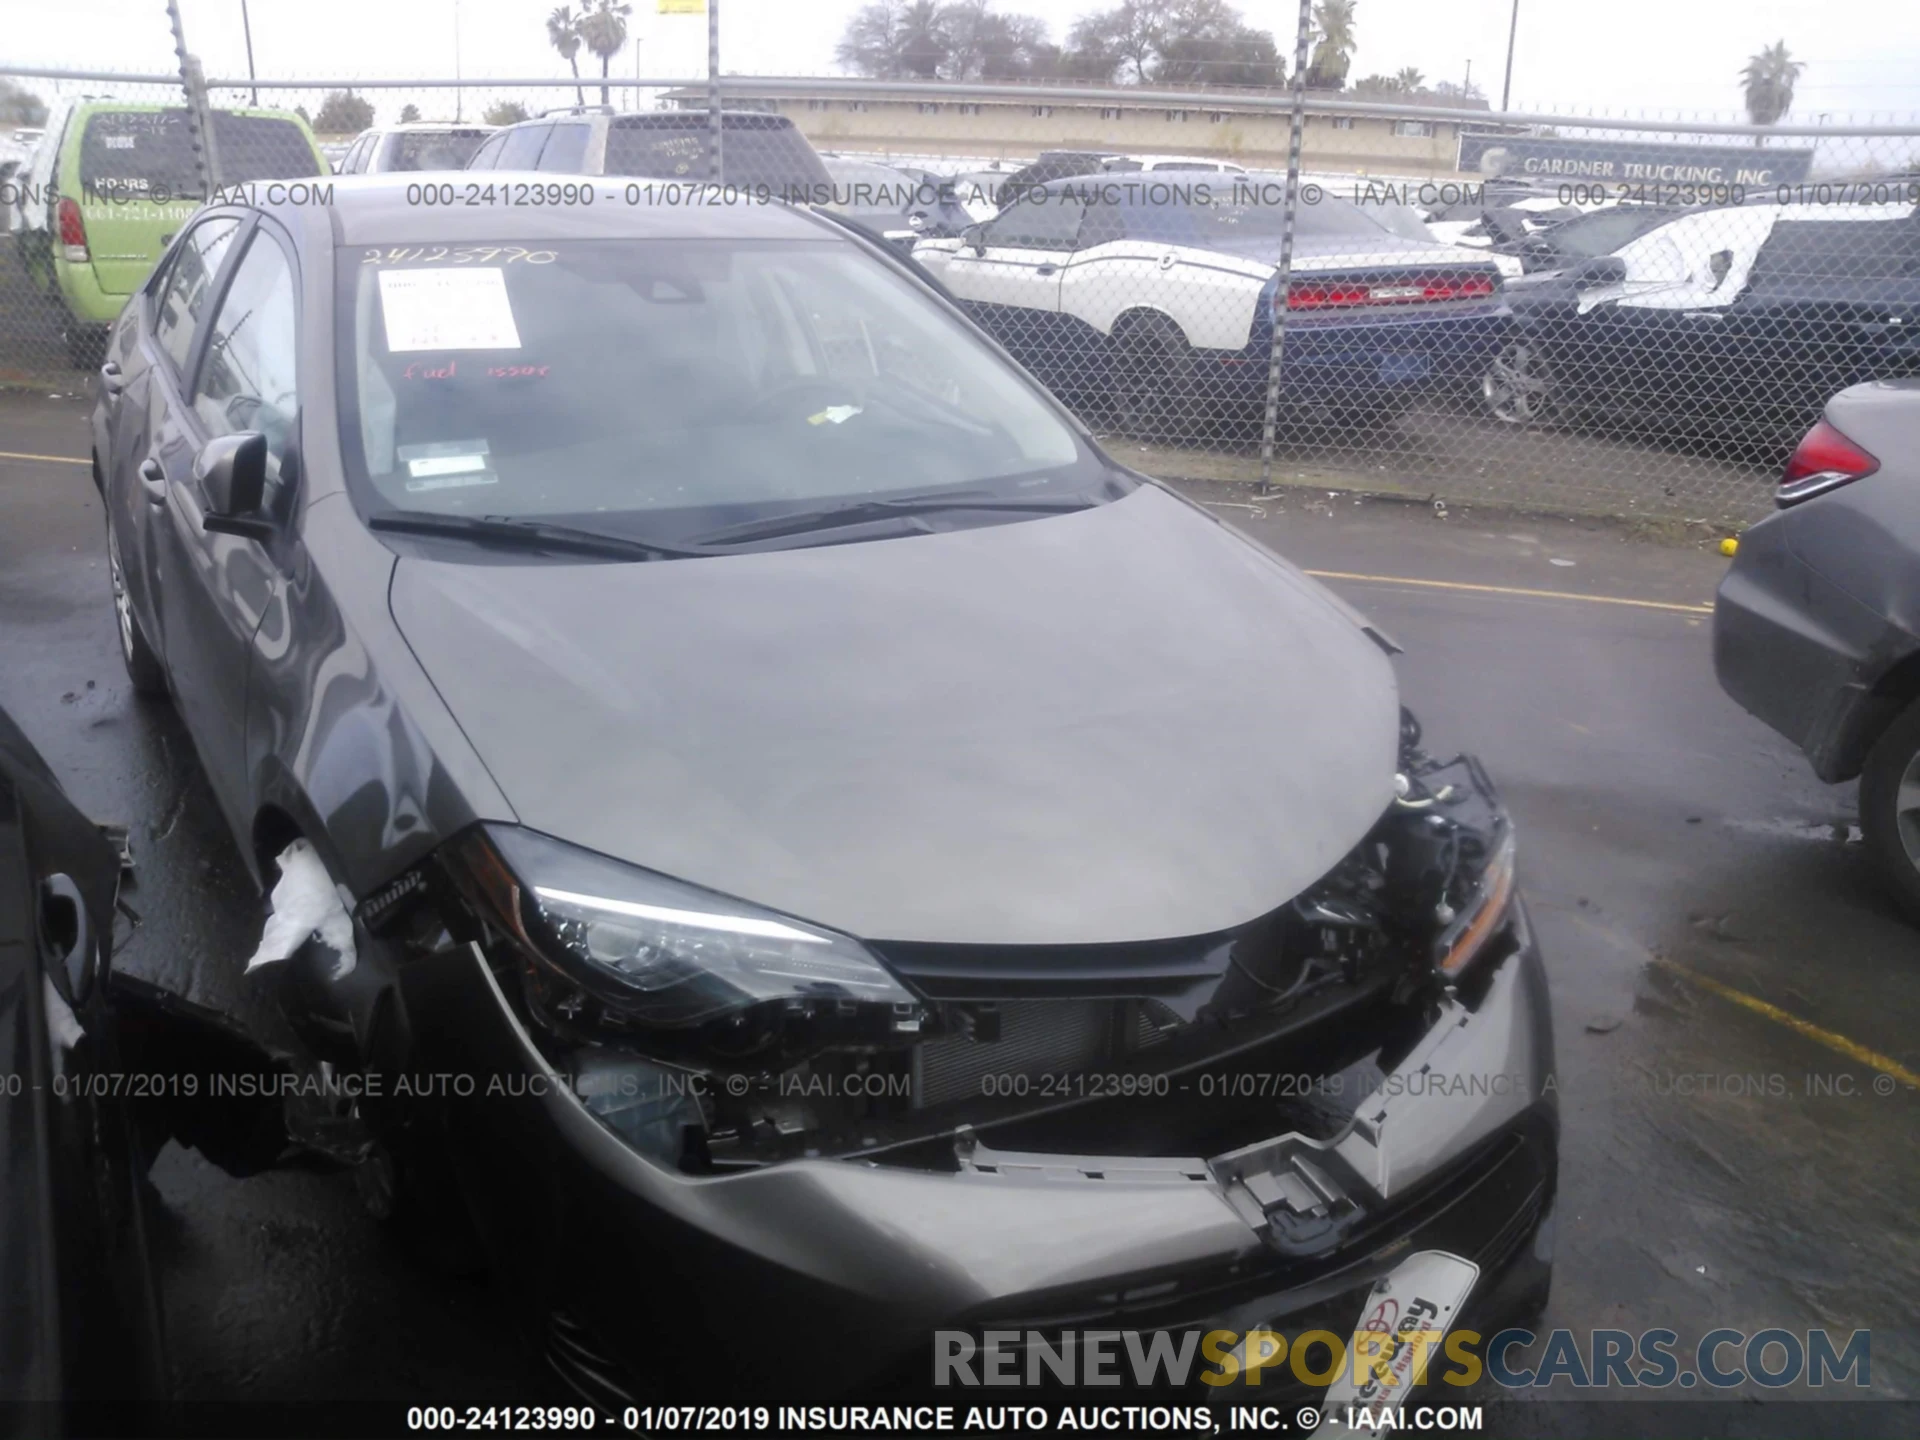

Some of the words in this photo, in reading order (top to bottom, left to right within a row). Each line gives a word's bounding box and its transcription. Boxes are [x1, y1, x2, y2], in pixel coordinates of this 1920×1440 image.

[1524, 157, 1613, 178] GARDNER
[1623, 163, 1729, 185] TRUCKING,
[1735, 168, 1772, 187] INC
